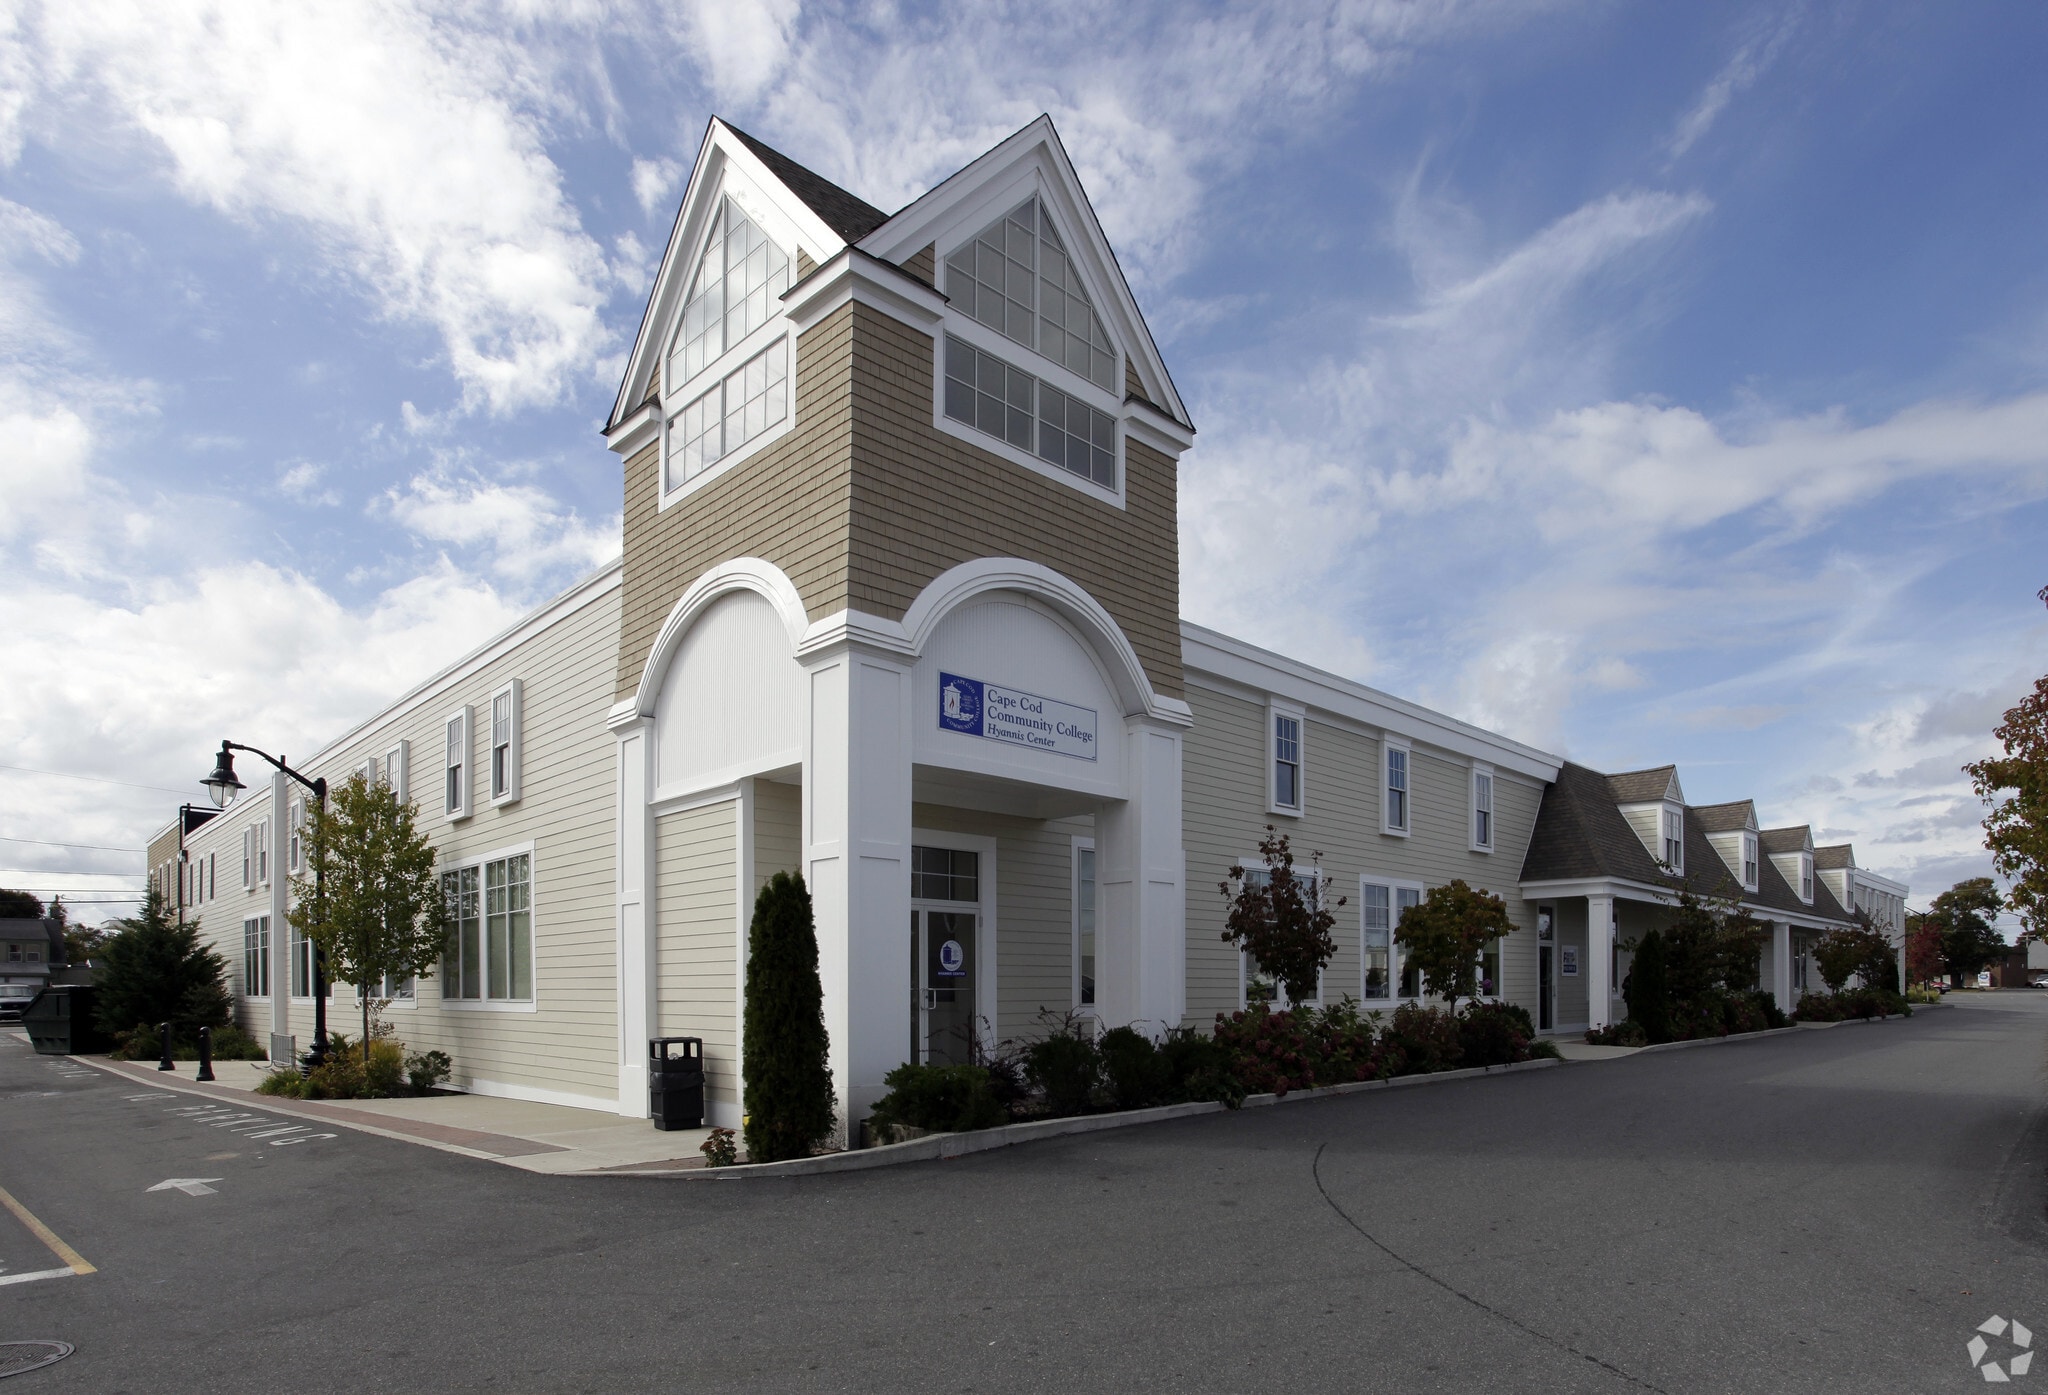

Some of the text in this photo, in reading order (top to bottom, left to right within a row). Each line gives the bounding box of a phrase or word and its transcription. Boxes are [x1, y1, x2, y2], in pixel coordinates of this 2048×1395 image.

[987, 688, 1017, 709] Cape
[1019, 697, 1043, 714] Cod
[987, 705, 1093, 744] Community College
[987, 723, 1056, 748] Hyannis Center
[162, 1104, 339, 1147] PARKING
